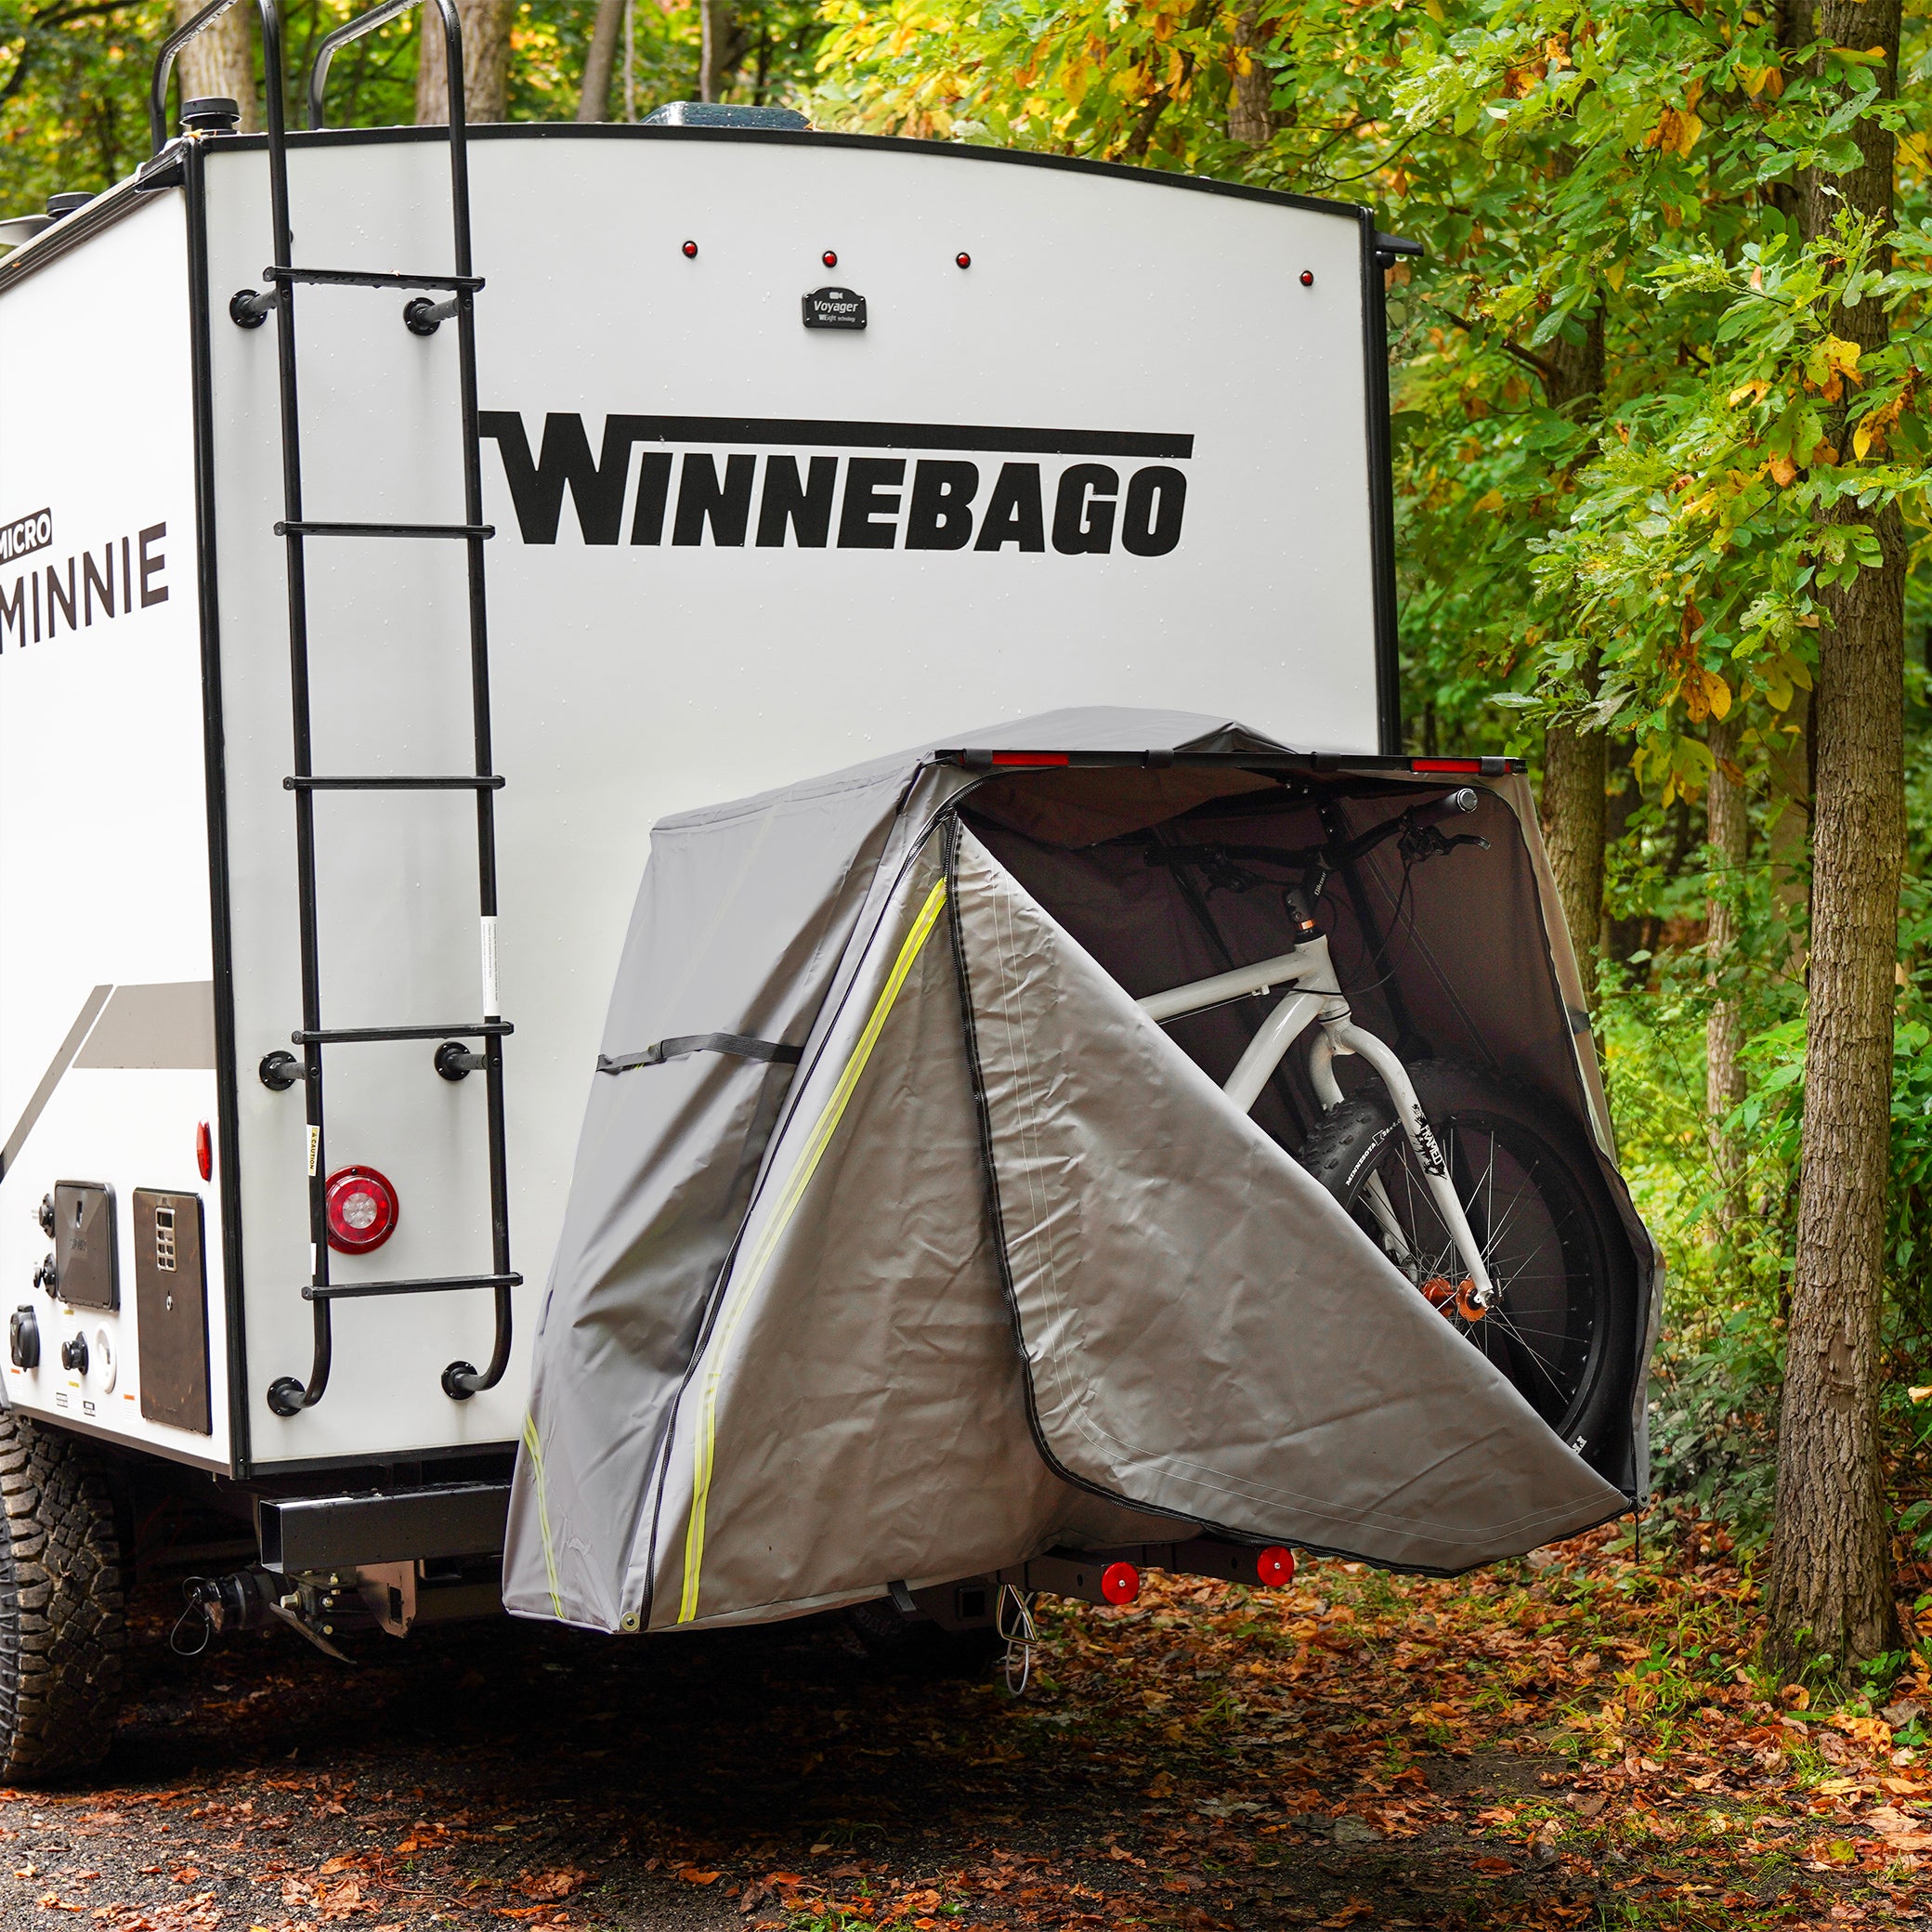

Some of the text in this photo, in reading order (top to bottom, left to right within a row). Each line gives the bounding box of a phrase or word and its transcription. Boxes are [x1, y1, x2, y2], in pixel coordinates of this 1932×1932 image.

[814, 300, 858, 314] Voyager
[479, 411, 1194, 557] WINNEBAGO
[0, 521, 169, 655] MINNIE
[1345, 1142, 1377, 1186] MINNESOTA
[1420, 1125, 1442, 1166] FRAMED
